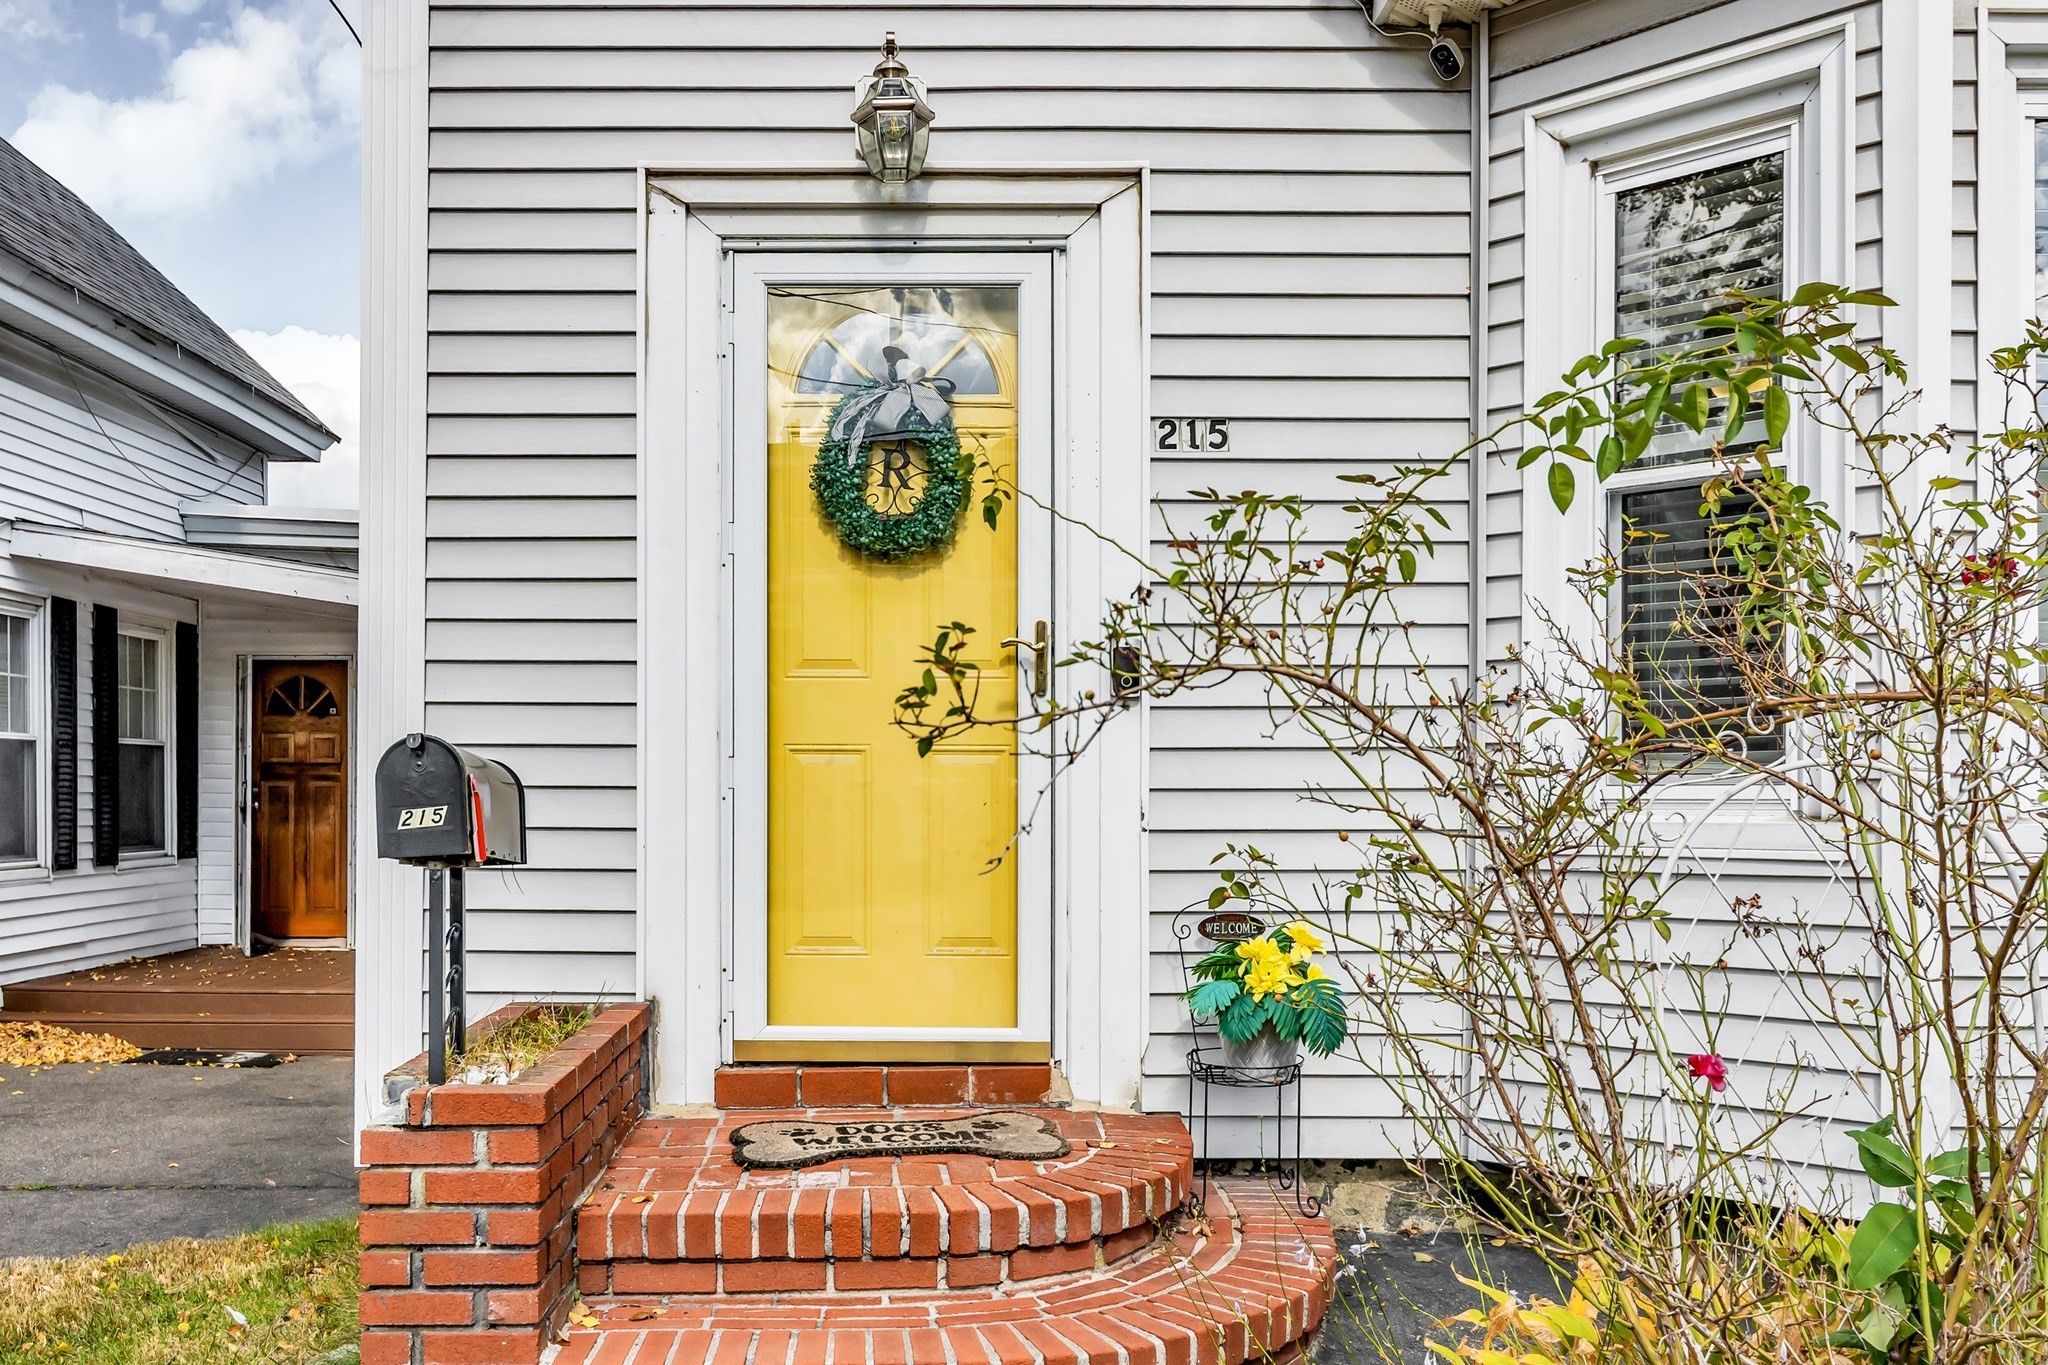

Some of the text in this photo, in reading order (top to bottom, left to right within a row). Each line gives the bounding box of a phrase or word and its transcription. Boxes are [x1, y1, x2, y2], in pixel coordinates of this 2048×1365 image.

[1158, 419, 1228, 450] 215
[877, 448, 915, 491] R
[401, 807, 444, 827] 215
[1205, 922, 1258, 934] WELCOME
[835, 1123, 945, 1135] DOGS
[792, 1131, 993, 1145] WELCOME
